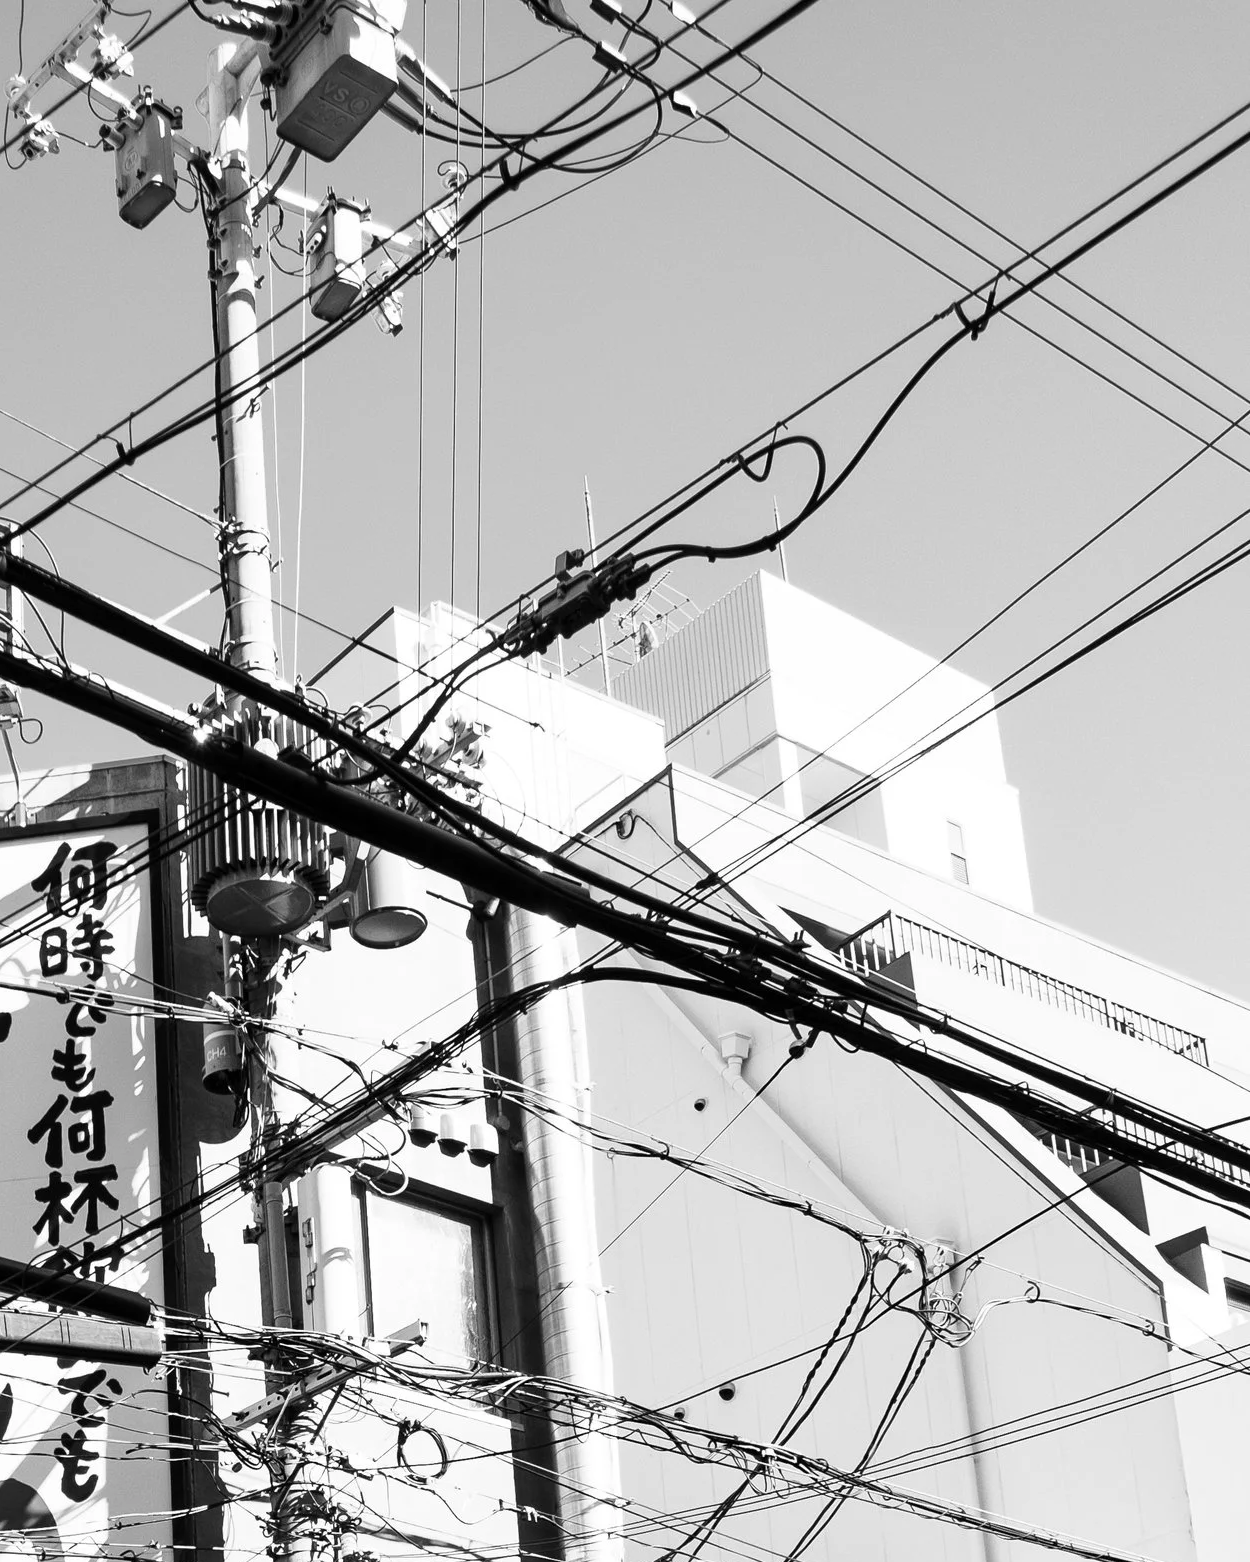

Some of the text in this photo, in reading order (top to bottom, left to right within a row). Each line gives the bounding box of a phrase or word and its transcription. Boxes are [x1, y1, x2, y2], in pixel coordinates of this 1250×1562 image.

[26, 840, 120, 1501] 何時でも何杯でも
[206, 1045, 228, 1064] CH4
